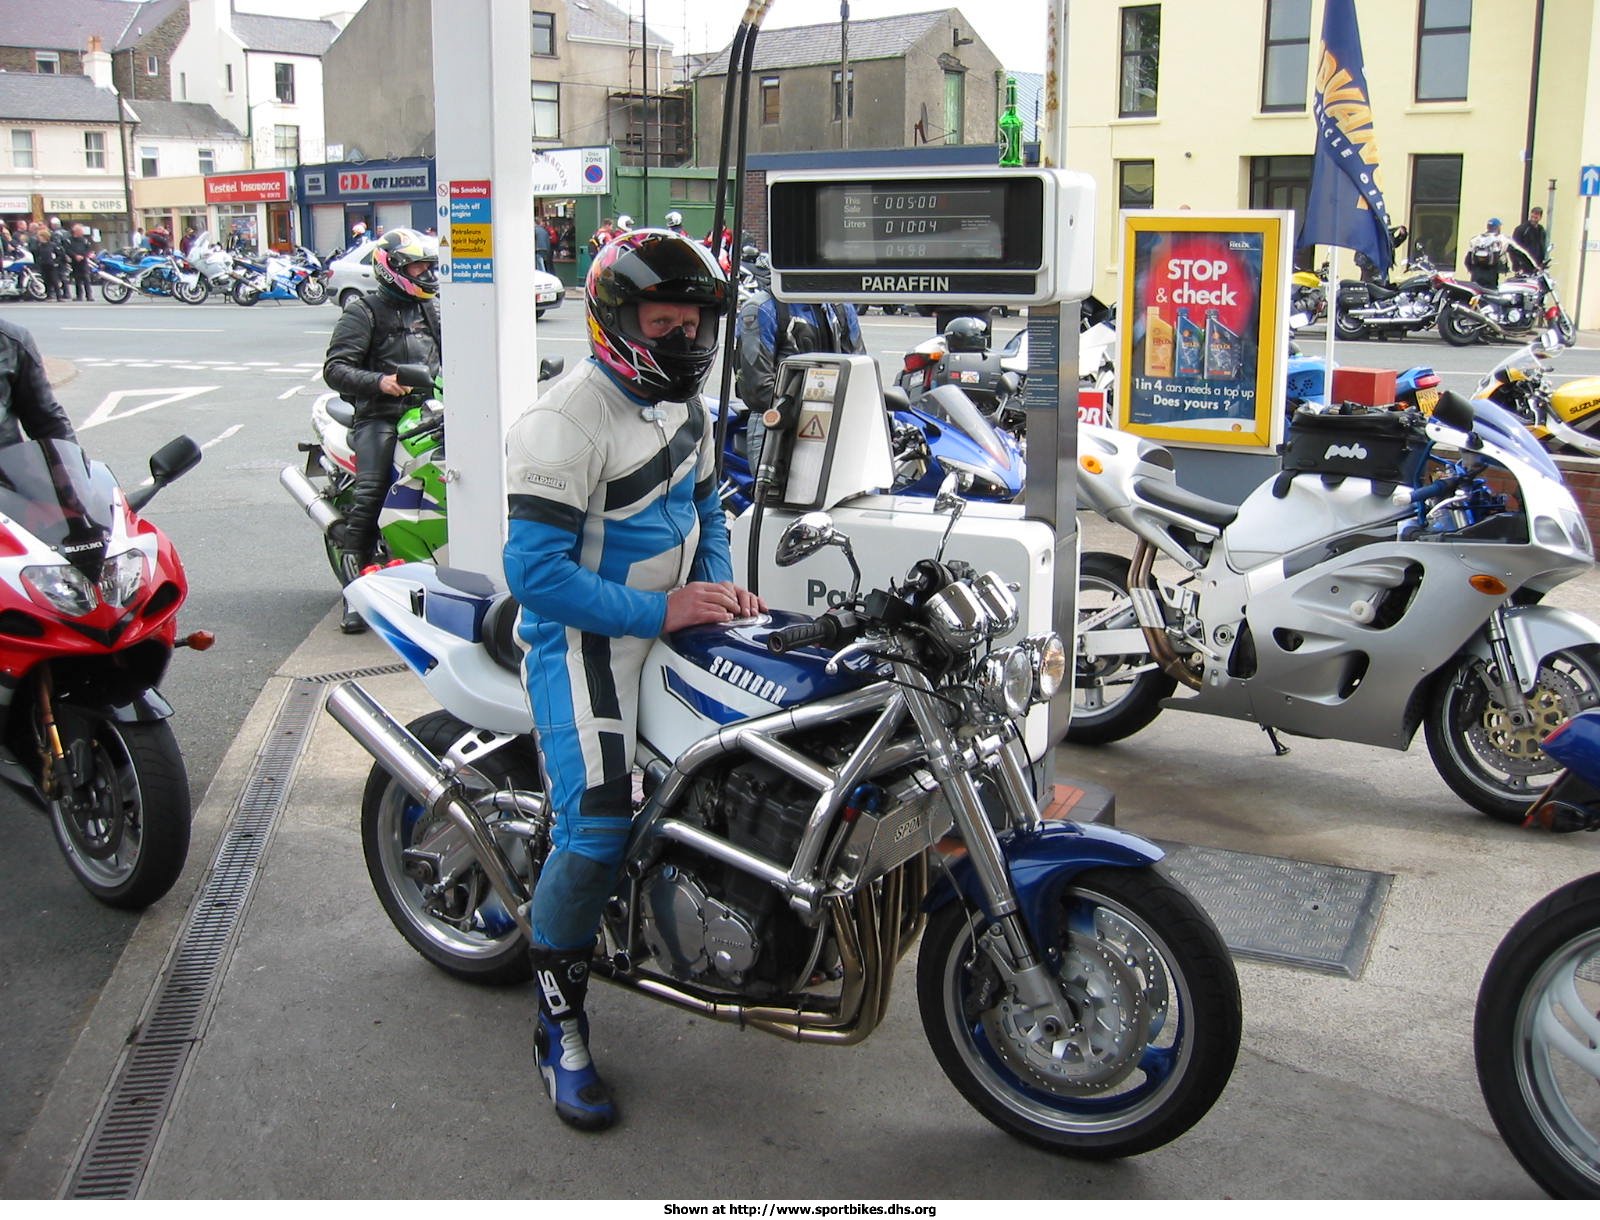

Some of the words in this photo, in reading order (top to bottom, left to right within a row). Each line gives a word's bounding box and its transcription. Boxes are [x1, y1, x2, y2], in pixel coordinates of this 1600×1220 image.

[209, 181, 238, 194] Kestrel
[240, 180, 281, 193] Insurance
[340, 173, 370, 191] CDL
[372, 177, 389, 190] OFF
[389, 175, 427, 189] LICENCE
[460, 186, 487, 195] Smoking
[50, 200, 73, 209] FISH
[79, 200, 86, 209] &
[92, 200, 122, 210] CHIPS
[844, 196, 861, 205] This
[451, 211, 472, 219] engine
[844, 204, 862, 214] Sale
[844, 219, 867, 229] Litres
[452, 237, 467, 246] spirit
[468, 237, 487, 246] highly
[453, 262, 471, 270] Switch
[472, 262, 482, 270] off
[482, 262, 491, 270] all
[1168, 258, 1228, 281] STOP
[453, 271, 472, 279] mobile
[472, 271, 492, 280] phones
[861, 276, 950, 292] PARAFFIN
[1155, 287, 1168, 304] &
[1172, 281, 1238, 306] check
[1140, 378, 1152, 391] in
[1153, 379, 1163, 392] 4
[1165, 383, 1183, 393] cars
[1184, 383, 1212, 395] needs
[1213, 388, 1221, 396] a
[1223, 386, 1239, 399] top
[1241, 389, 1255, 400] up
[1153, 394, 1180, 408] Does
[1183, 398, 1219, 411] yours
[1223, 400, 1231, 411] ?
[1568, 397, 1600, 415] SUZUK
[64, 541, 104, 553] SUZUKI
[709, 655, 788, 705] SPONDON
